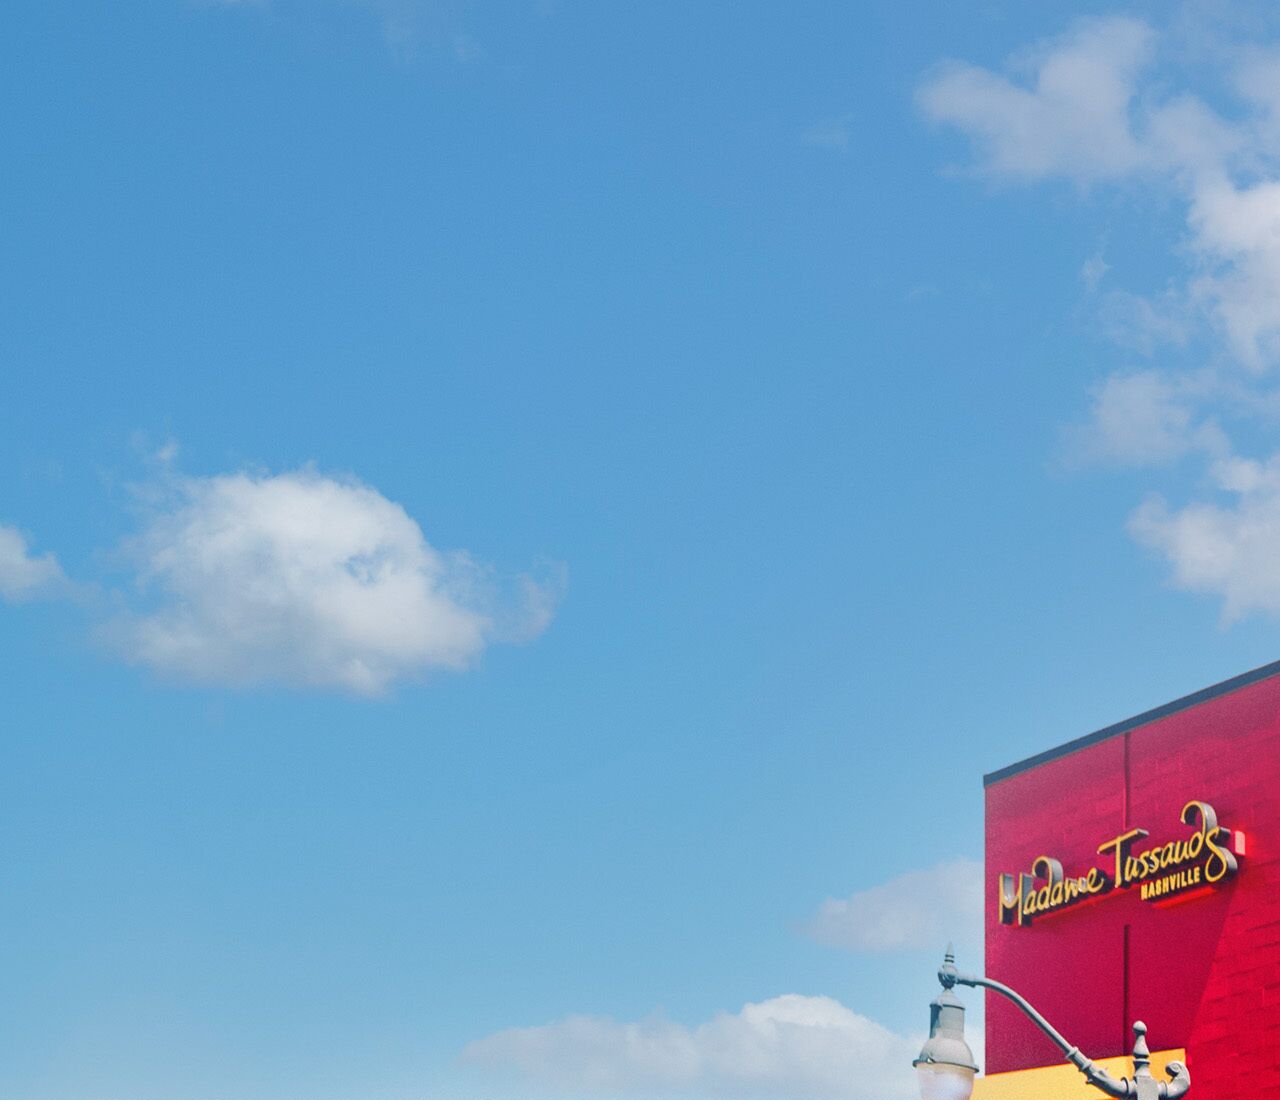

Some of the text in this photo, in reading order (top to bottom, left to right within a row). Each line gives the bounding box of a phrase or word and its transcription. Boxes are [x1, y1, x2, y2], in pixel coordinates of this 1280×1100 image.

[999, 800, 1234, 926] Madame Tussauds
[1140, 866, 1201, 901] NASHVILLE
